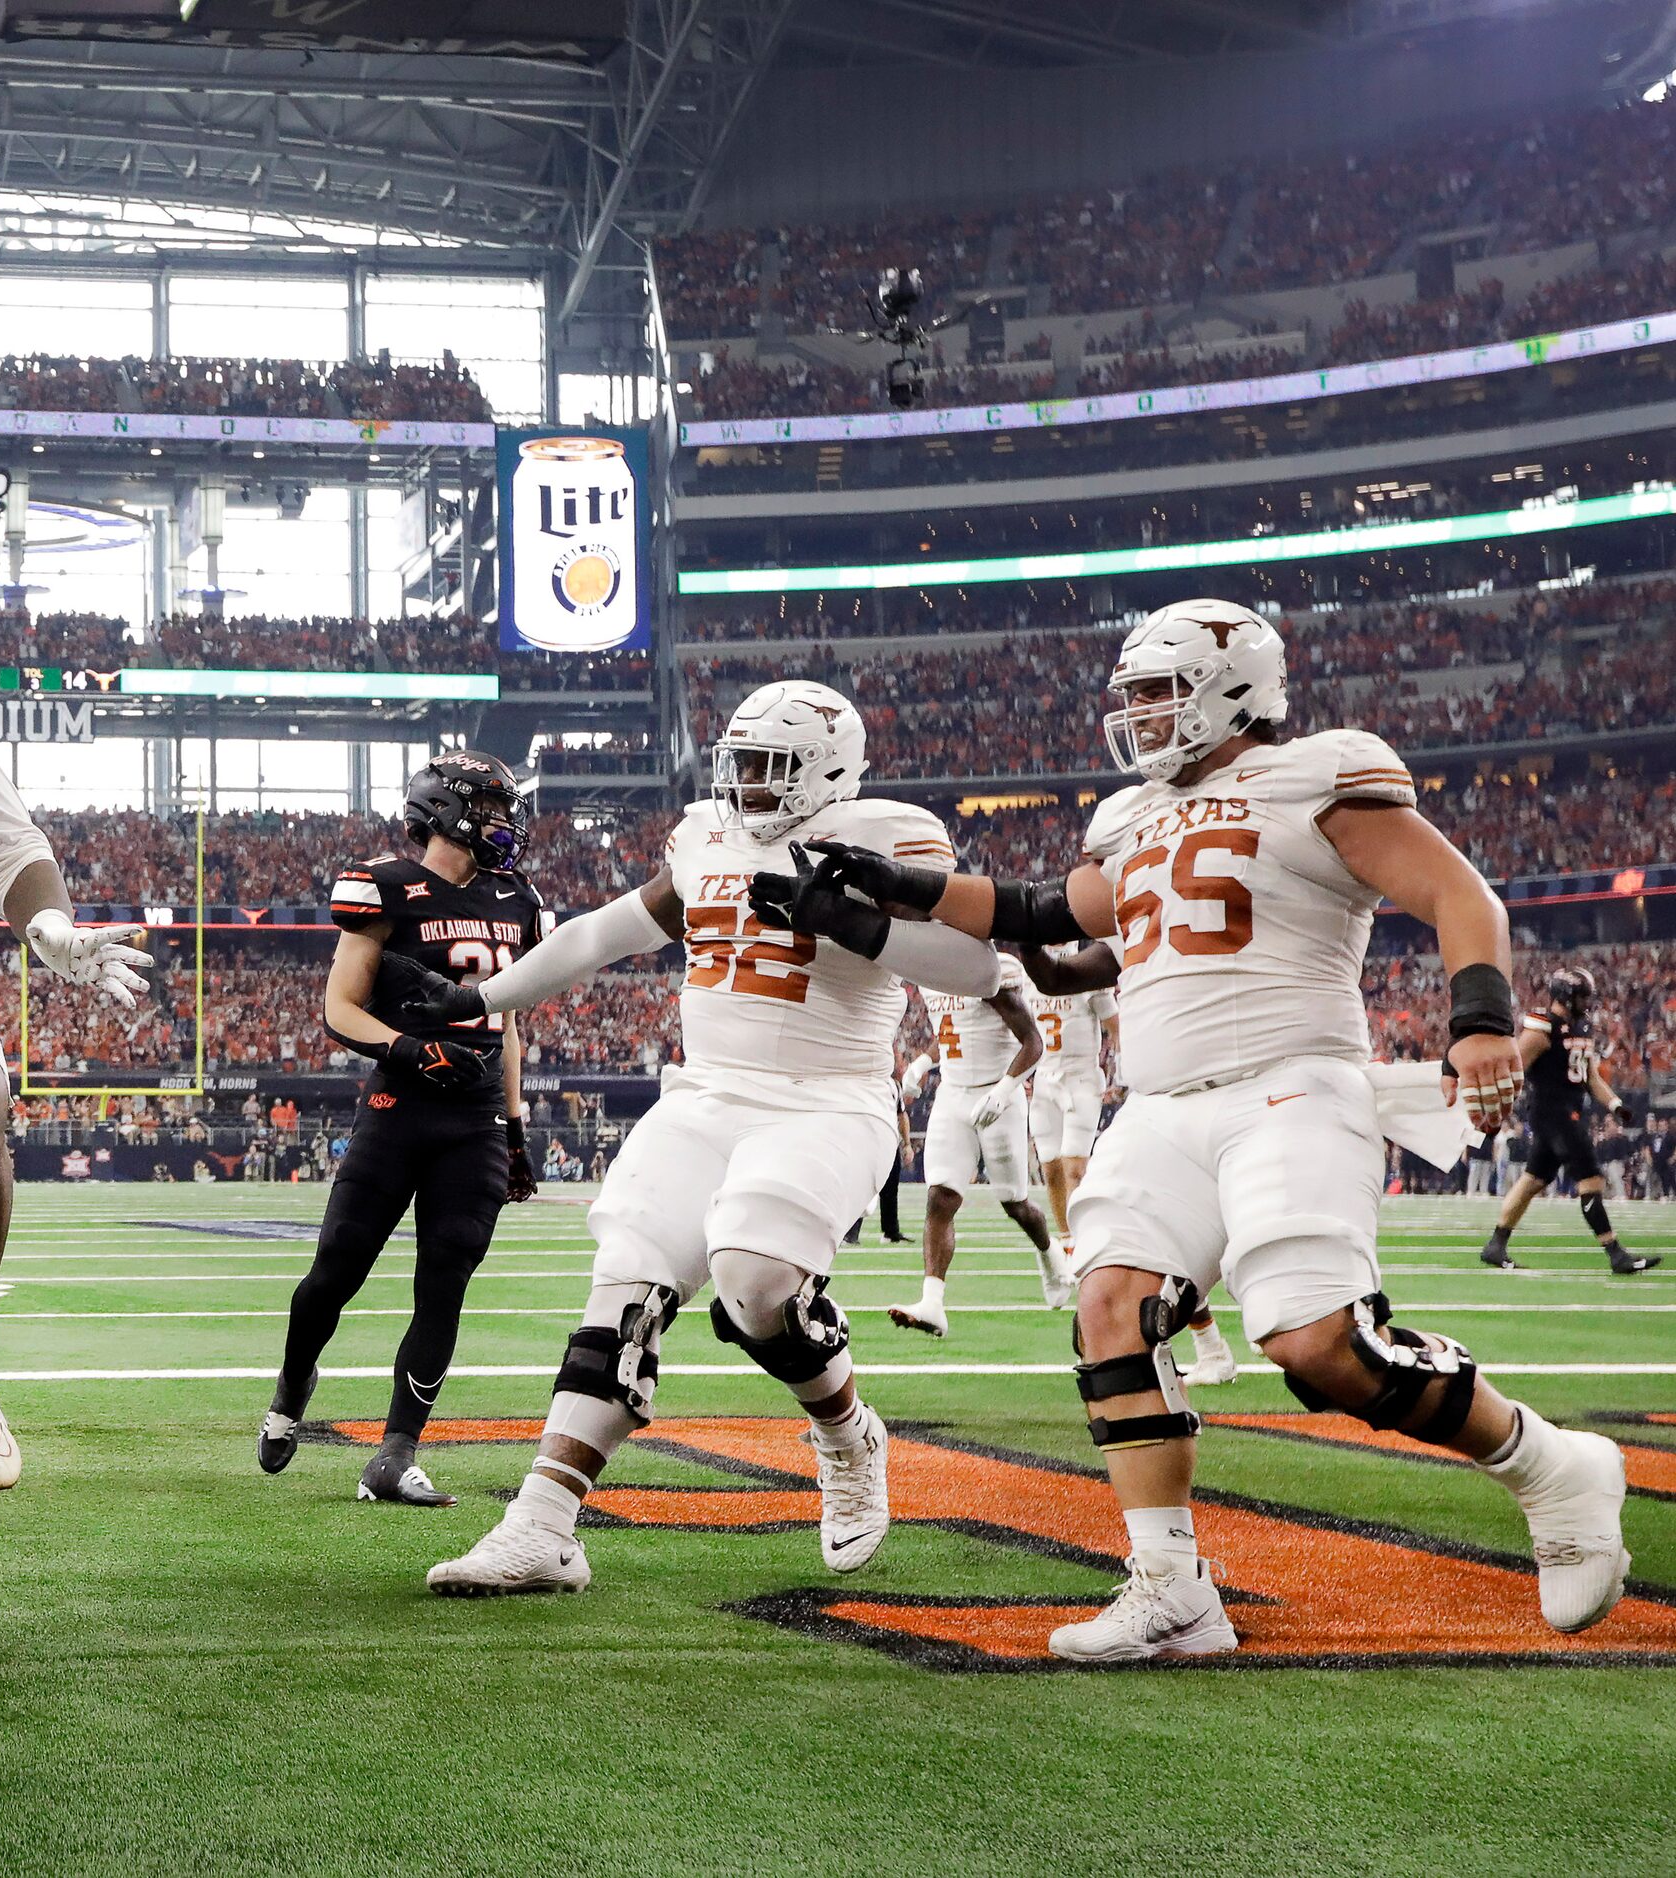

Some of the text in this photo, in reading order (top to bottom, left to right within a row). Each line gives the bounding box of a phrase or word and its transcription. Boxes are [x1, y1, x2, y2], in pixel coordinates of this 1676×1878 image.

[538, 485, 628, 538] Lite
[62, 671, 87, 690] 14
[428, 753, 491, 772] wboys
[1134, 798, 1250, 849] TEXAS
[699, 875, 753, 901] TEX
[1116, 829, 1260, 968] 65
[420, 920, 491, 942] OKLAHOMA
[685, 906, 816, 1004] 52
[938, 1014, 963, 1059] 4
[1037, 1013, 1062, 1052] 3
[159, 1078, 191, 1089] HOOK
[218, 1079, 257, 1091] HORNS
[522, 1078, 560, 1091] HORNS
